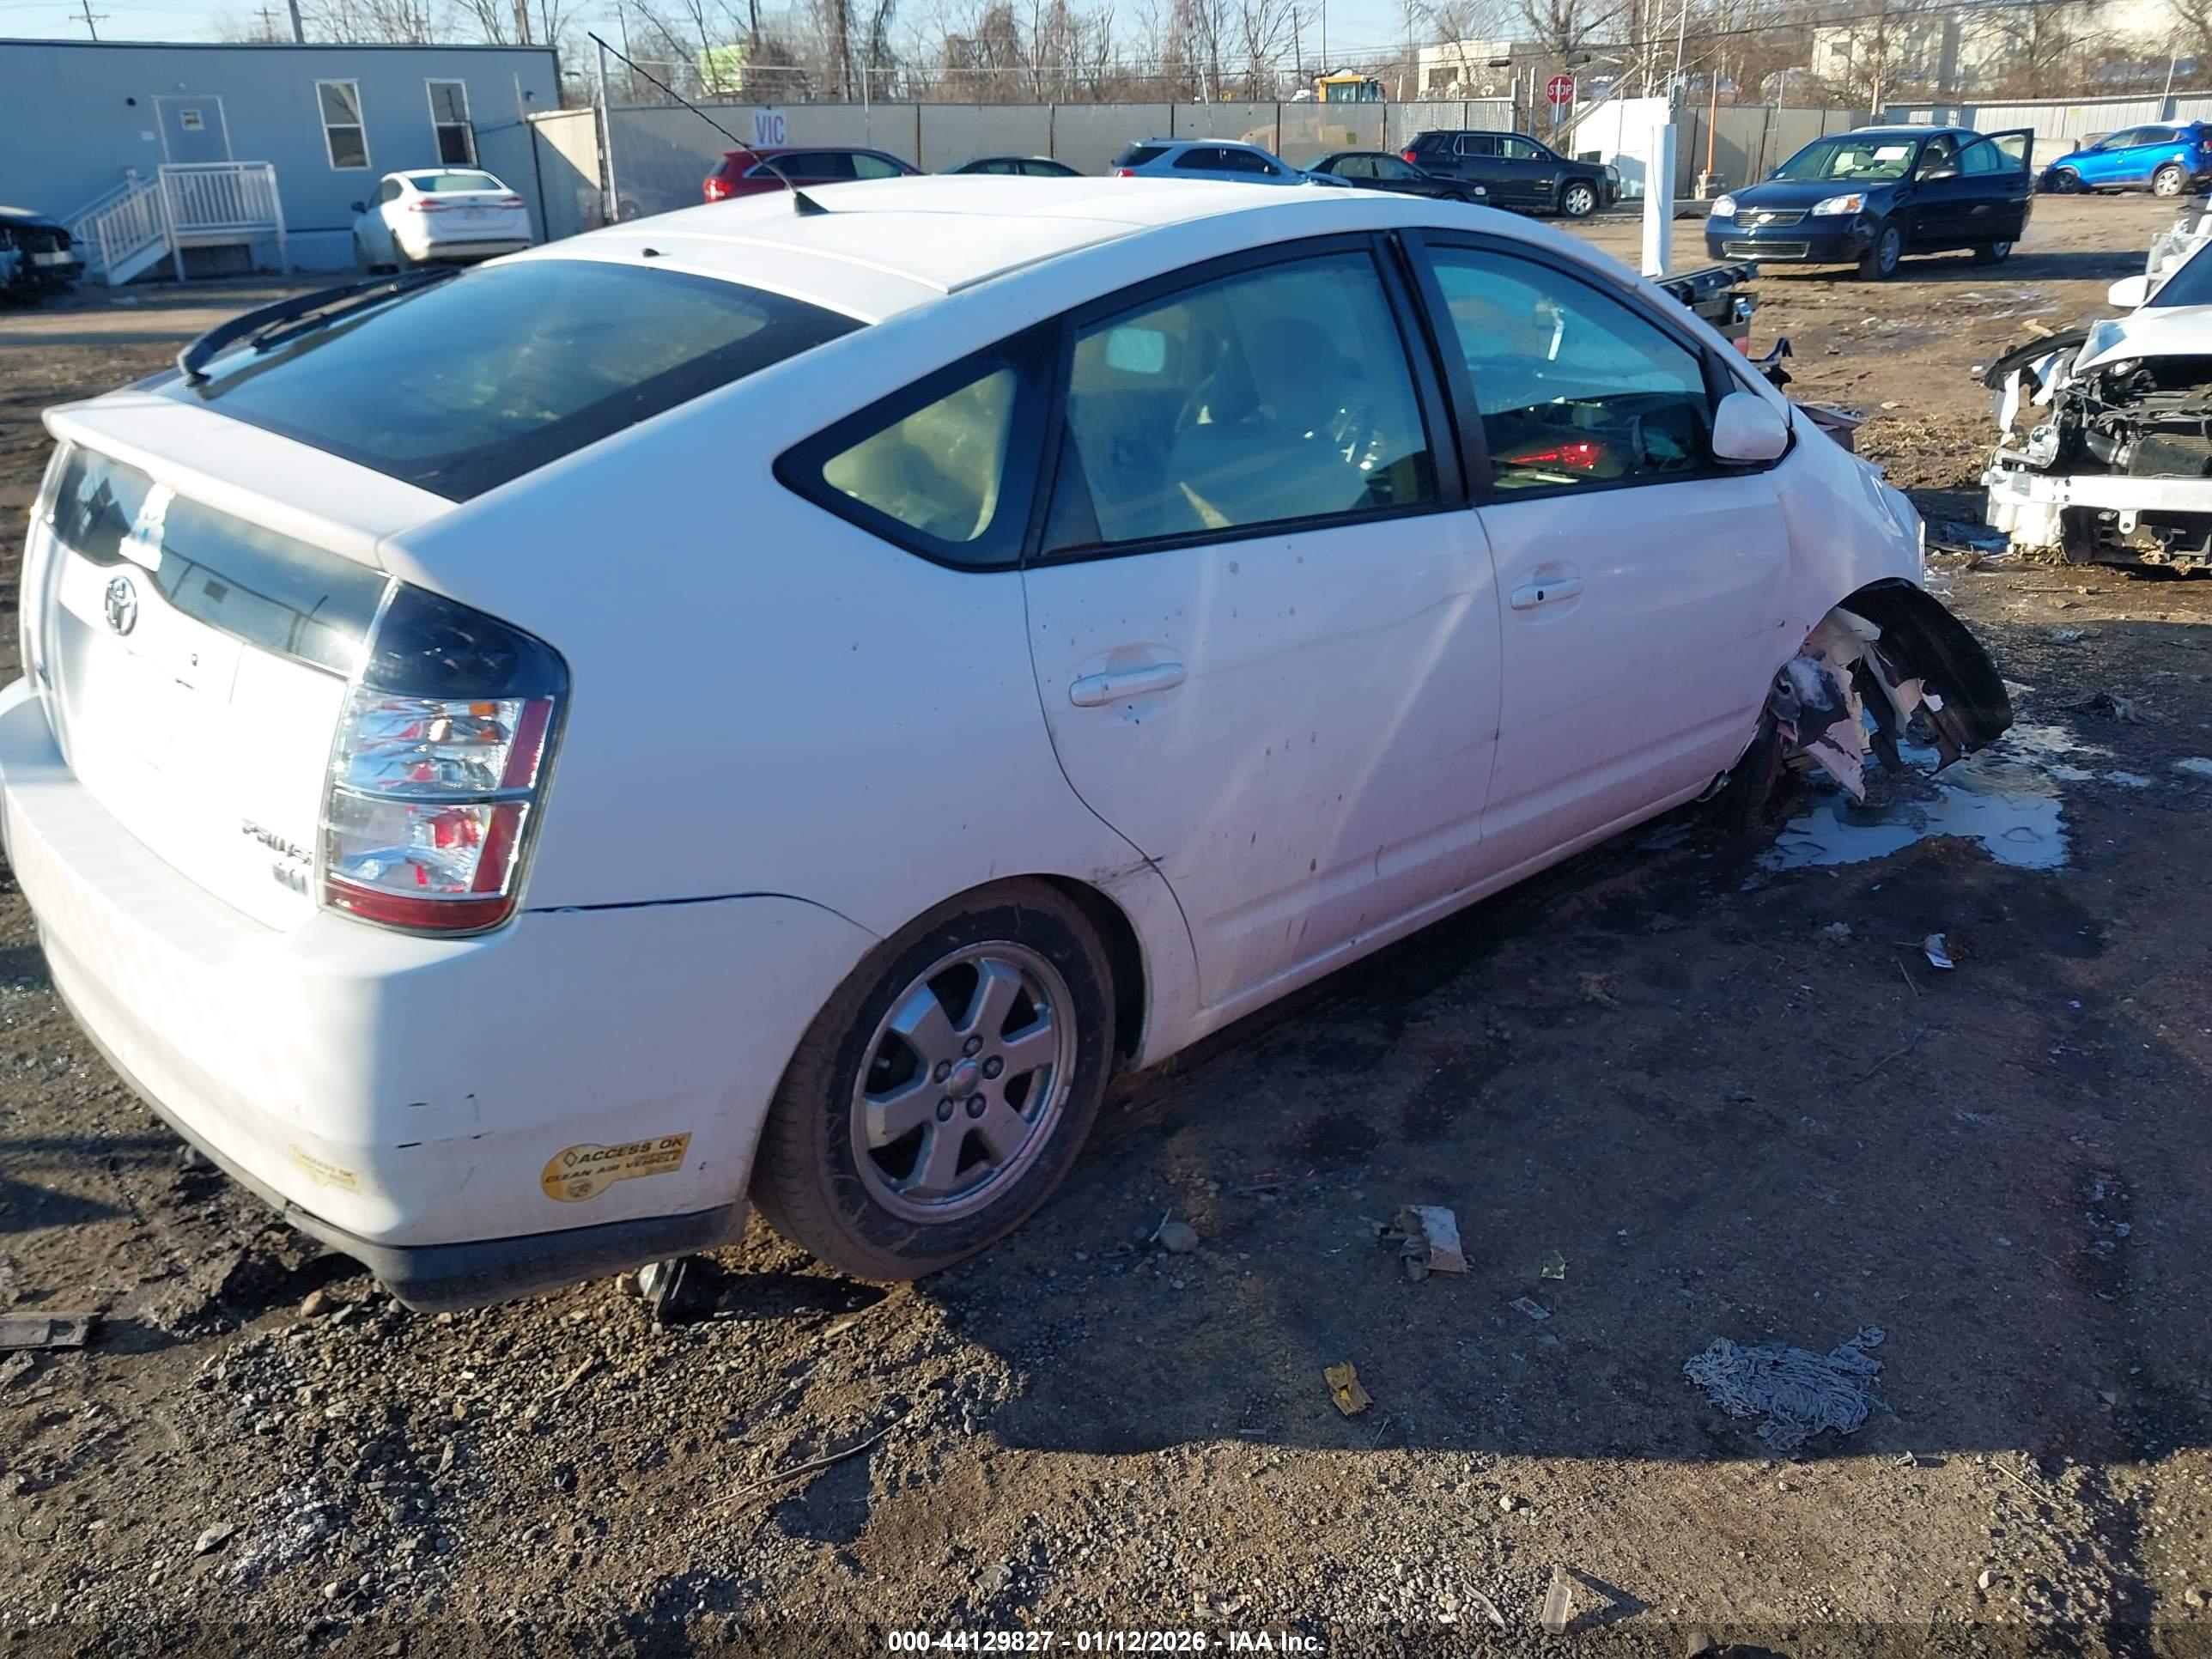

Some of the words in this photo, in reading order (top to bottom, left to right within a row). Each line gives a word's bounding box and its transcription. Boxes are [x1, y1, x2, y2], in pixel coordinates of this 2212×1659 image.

[1548, 83, 1572, 96] STOP
[756, 115, 784, 144] VIC
[578, 1142, 652, 1164] ACCESS
[659, 1137, 685, 1150] OK
[545, 1170, 592, 1183] CLEAN
[596, 1164, 620, 1174] AIR
[626, 1153, 681, 1169] VEHICLE
